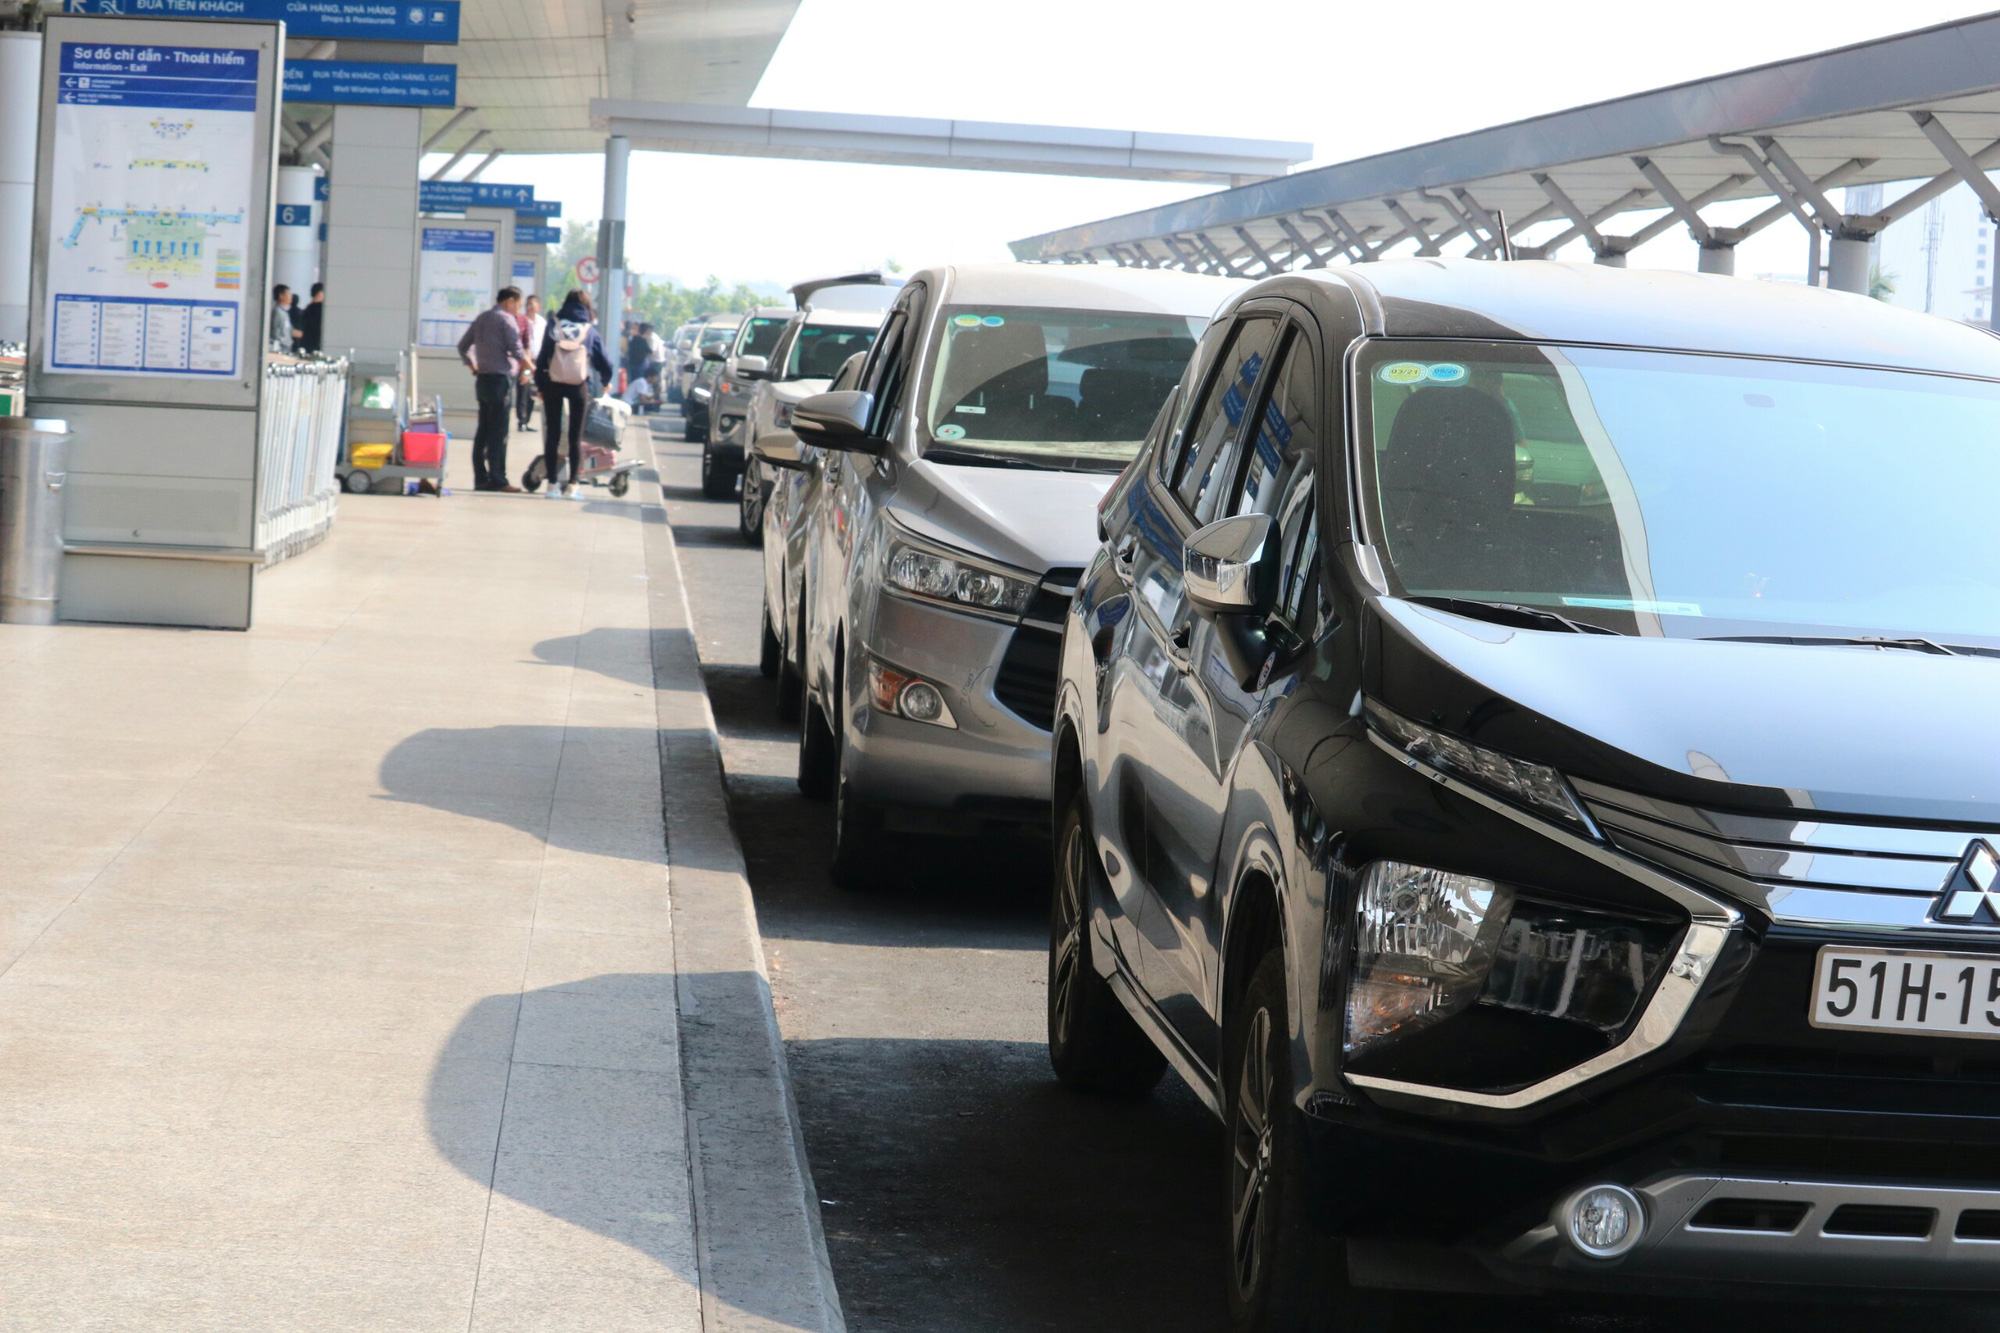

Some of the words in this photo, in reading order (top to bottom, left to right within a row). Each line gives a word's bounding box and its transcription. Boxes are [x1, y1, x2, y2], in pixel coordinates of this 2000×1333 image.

[173, 51, 210, 64] Thoát
[213, 51, 245, 65] hiểm
[73, 62, 123, 72] Information
[130, 64, 148, 72] Exit
[282, 206, 295, 223] 6
